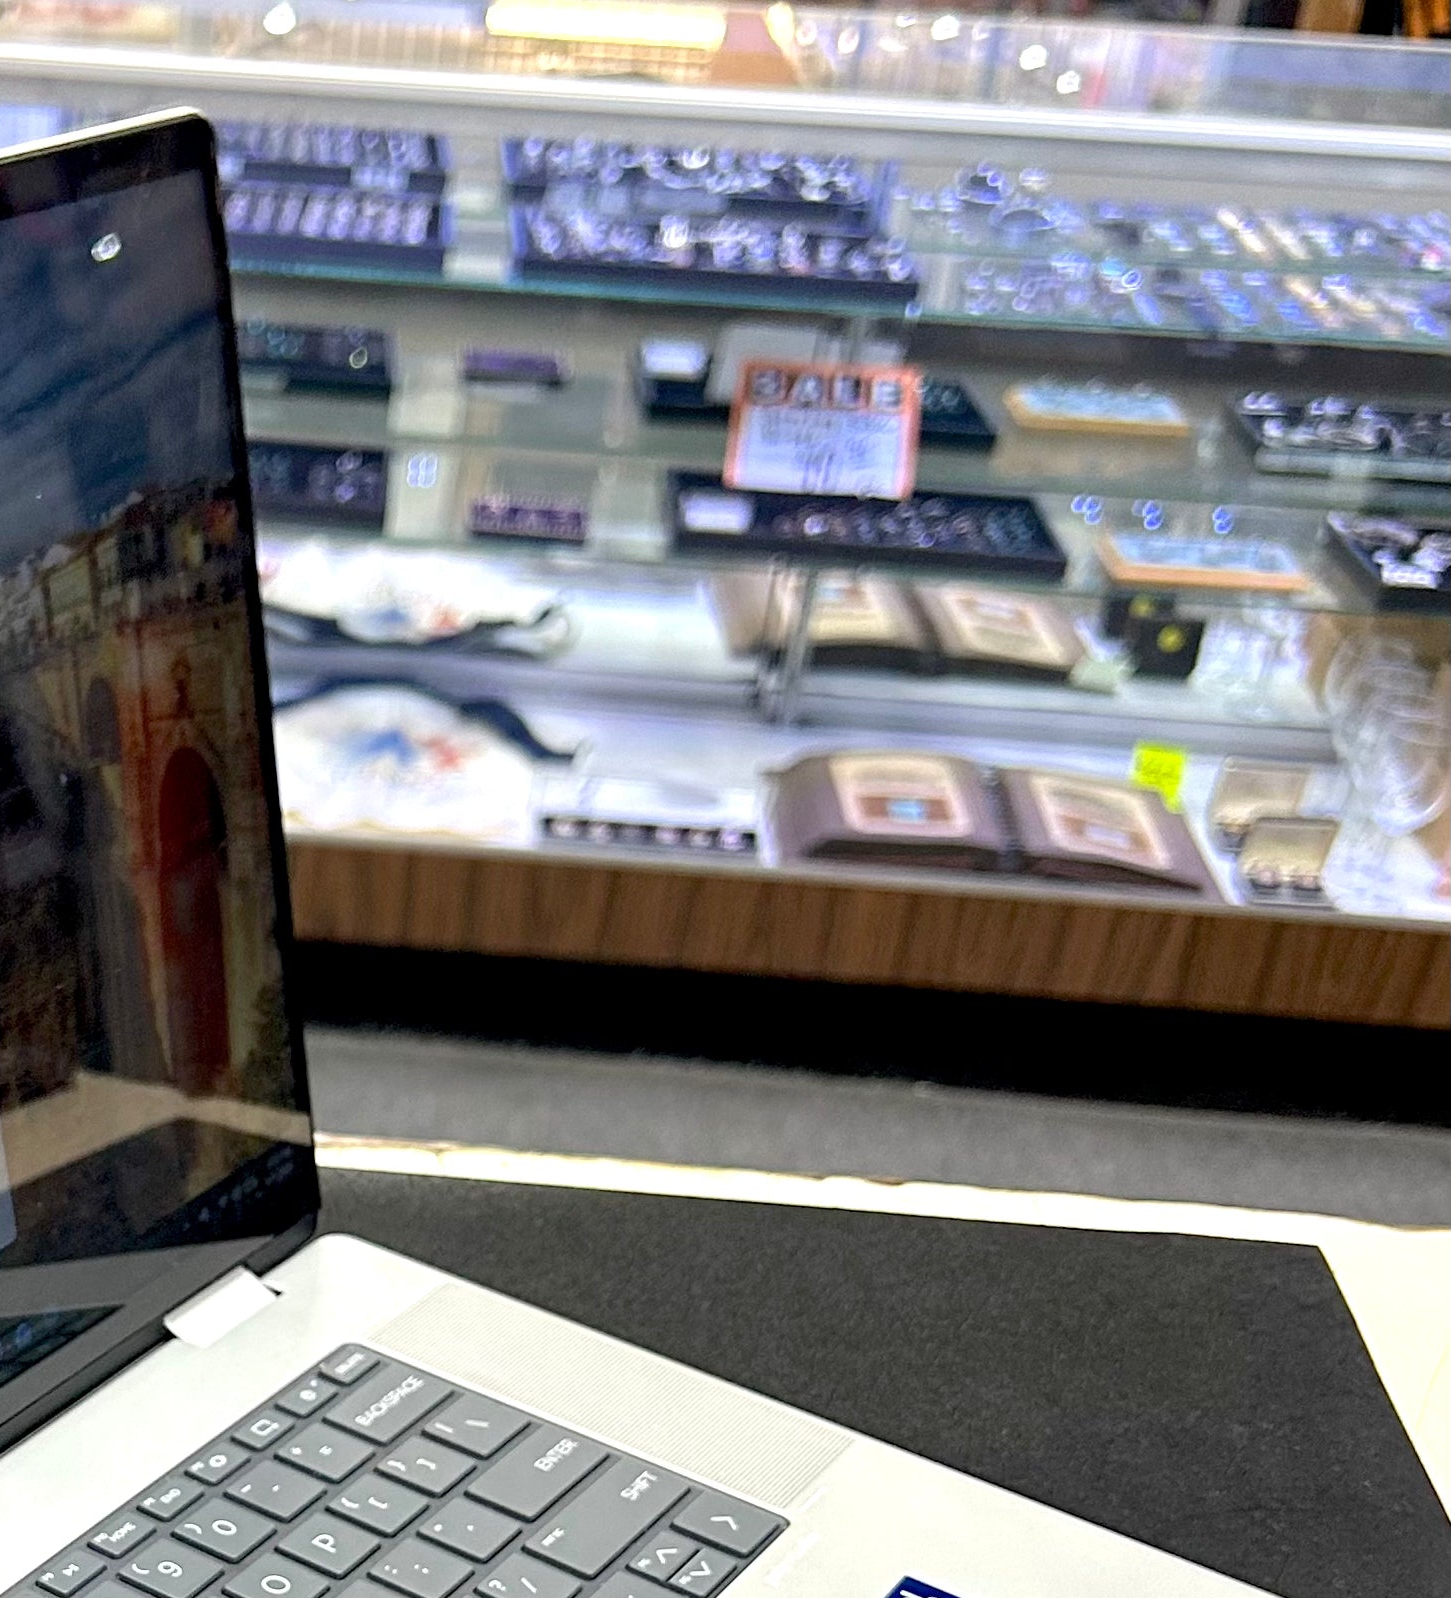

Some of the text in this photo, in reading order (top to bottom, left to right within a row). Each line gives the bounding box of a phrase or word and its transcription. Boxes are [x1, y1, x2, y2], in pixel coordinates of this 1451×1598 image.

[354, 1375, 424, 1427] BACKSPACE
[533, 1438, 578, 1472] ENTER
[620, 1470, 658, 1501] SHIFT
[311, 1533, 337, 1554] P
[157, 1561, 183, 1578] 9
[260, 1574, 291, 1595] O
